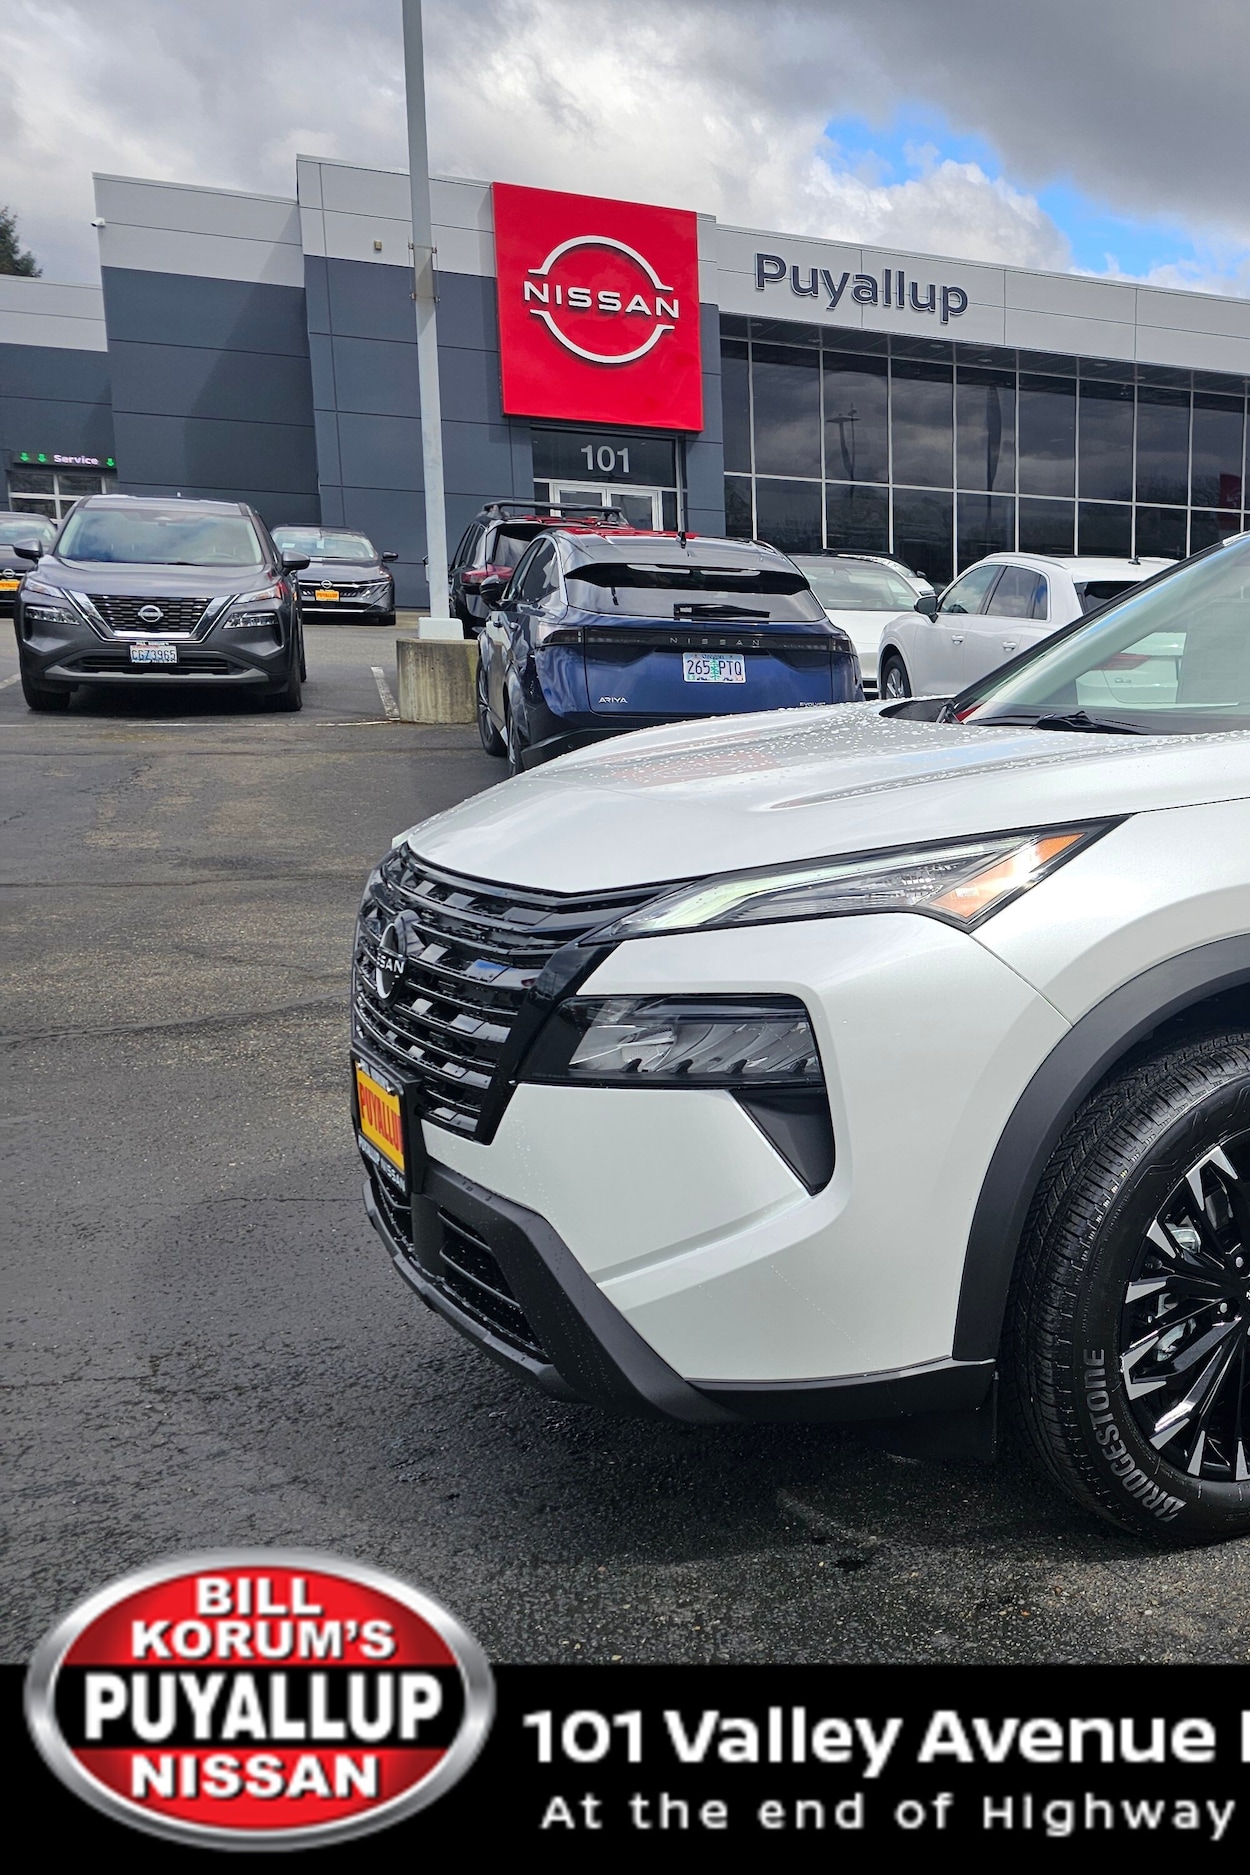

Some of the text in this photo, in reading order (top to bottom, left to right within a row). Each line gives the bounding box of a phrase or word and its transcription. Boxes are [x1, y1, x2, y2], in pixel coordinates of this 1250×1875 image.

[523, 281, 679, 318] NISSAN
[755, 253, 969, 324] Puyallup
[53, 454, 98, 465] Service
[580, 445, 630, 473] 101
[669, 637, 760, 647] NISSAN
[687, 659, 742, 676] 265 PTQ
[599, 696, 628, 704] ARIYA
[1084, 1348, 1187, 1523] BRIDGESTONE
